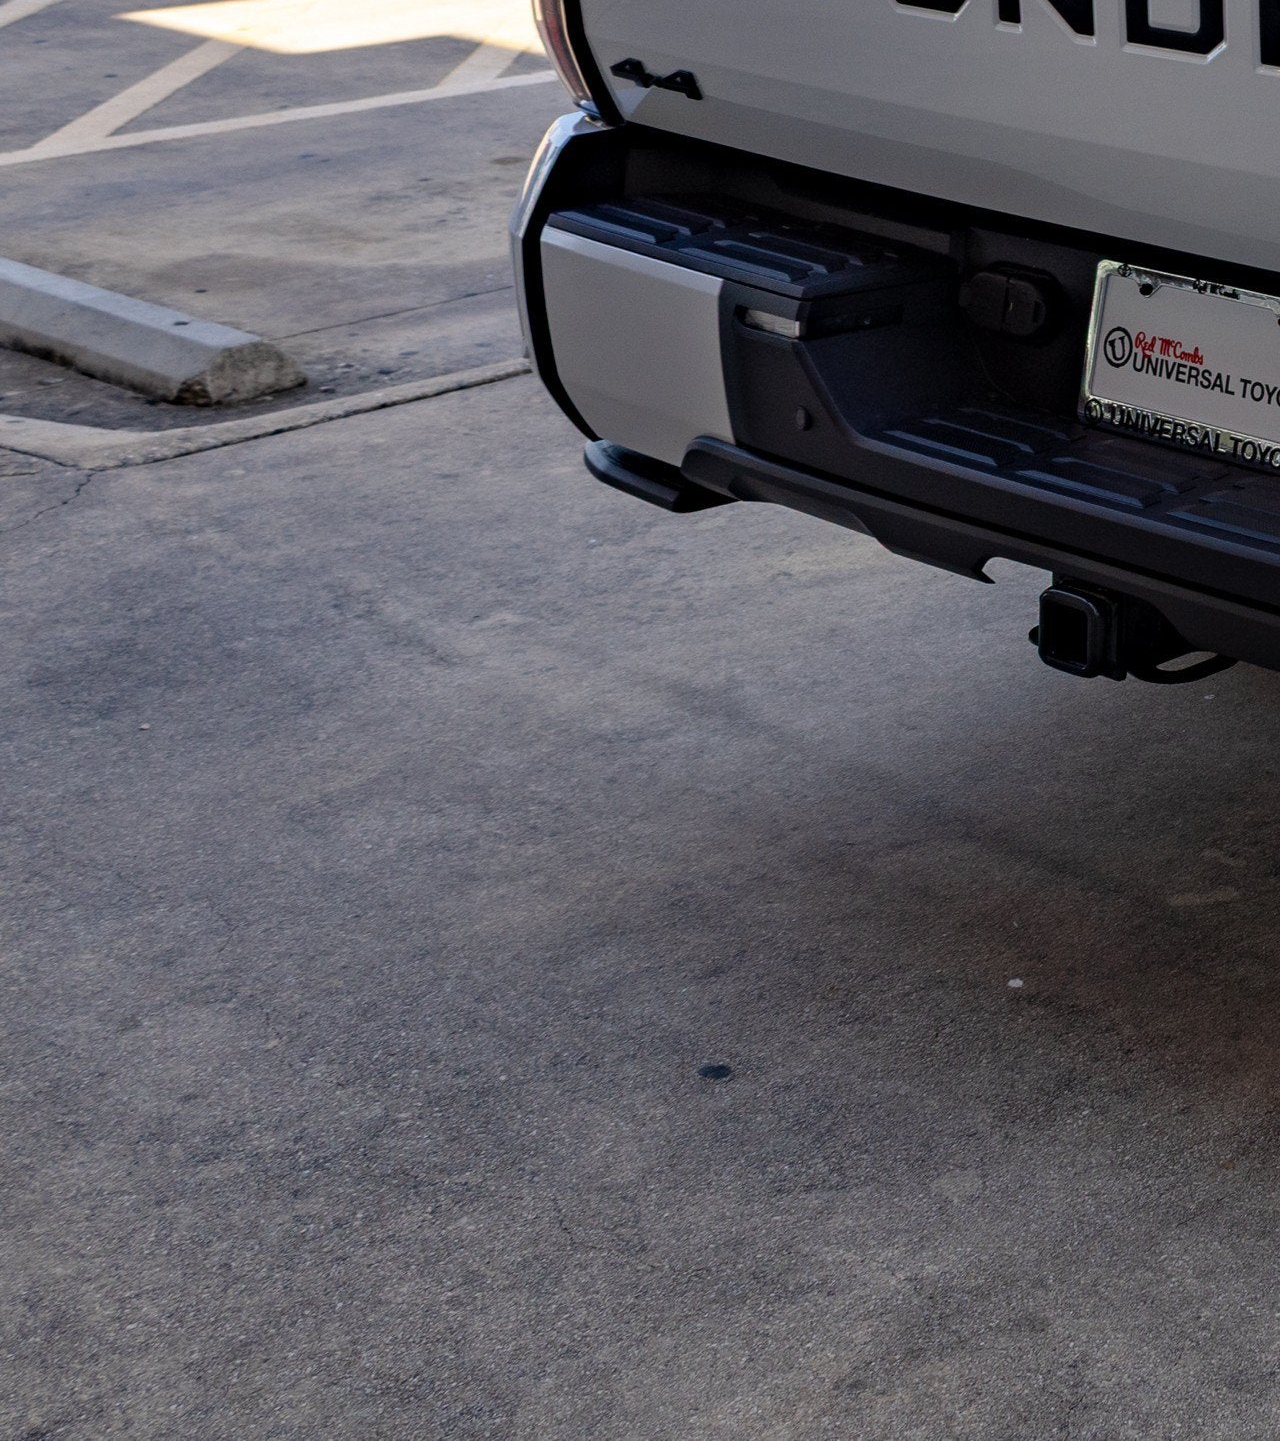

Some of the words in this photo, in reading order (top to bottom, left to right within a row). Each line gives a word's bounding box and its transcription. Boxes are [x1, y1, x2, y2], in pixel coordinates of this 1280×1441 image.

[1134, 331, 1156, 359] Red
[1159, 337, 1204, 365] McCombs
[1132, 352, 1235, 396] UNIVERSAL
[1110, 403, 1228, 454] UNIVERSAL
